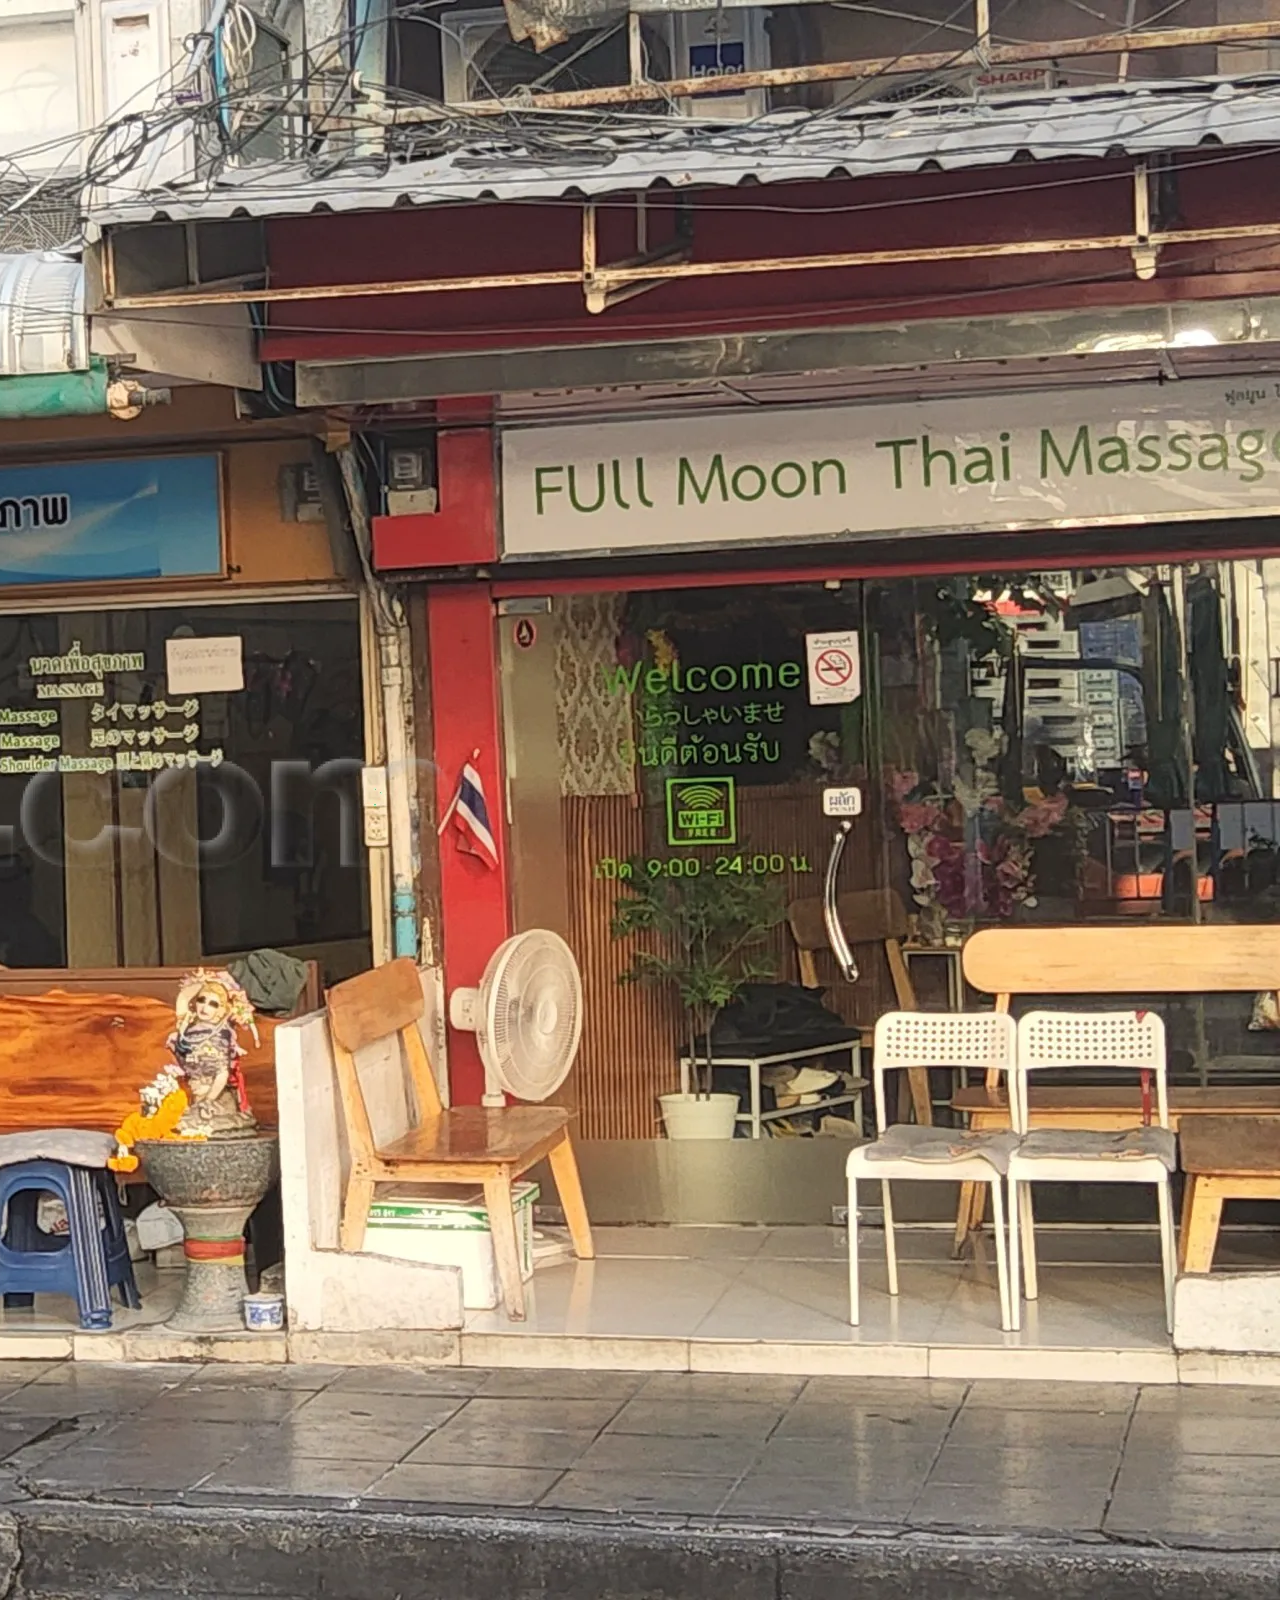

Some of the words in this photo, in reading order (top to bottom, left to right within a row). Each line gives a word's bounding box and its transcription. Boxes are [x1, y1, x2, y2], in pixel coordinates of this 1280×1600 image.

[977, 69, 1045, 86] SHARP
[677, 454, 848, 505] Moon
[875, 431, 1011, 489] Thai
[1039, 424, 1280, 484] Massag
[29, 640, 145, 679] นวดเพื่อสุขภาพ
[601, 660, 801, 696] Welcome
[37, 682, 104, 699] MASSAGE
[91, 699, 199, 722] タイマッサージ
[0, 733, 60, 752] Massage
[620, 732, 780, 767] นดีต้อนรับ
[0, 755, 58, 773] Shoulder
[59, 755, 113, 774] Massage
